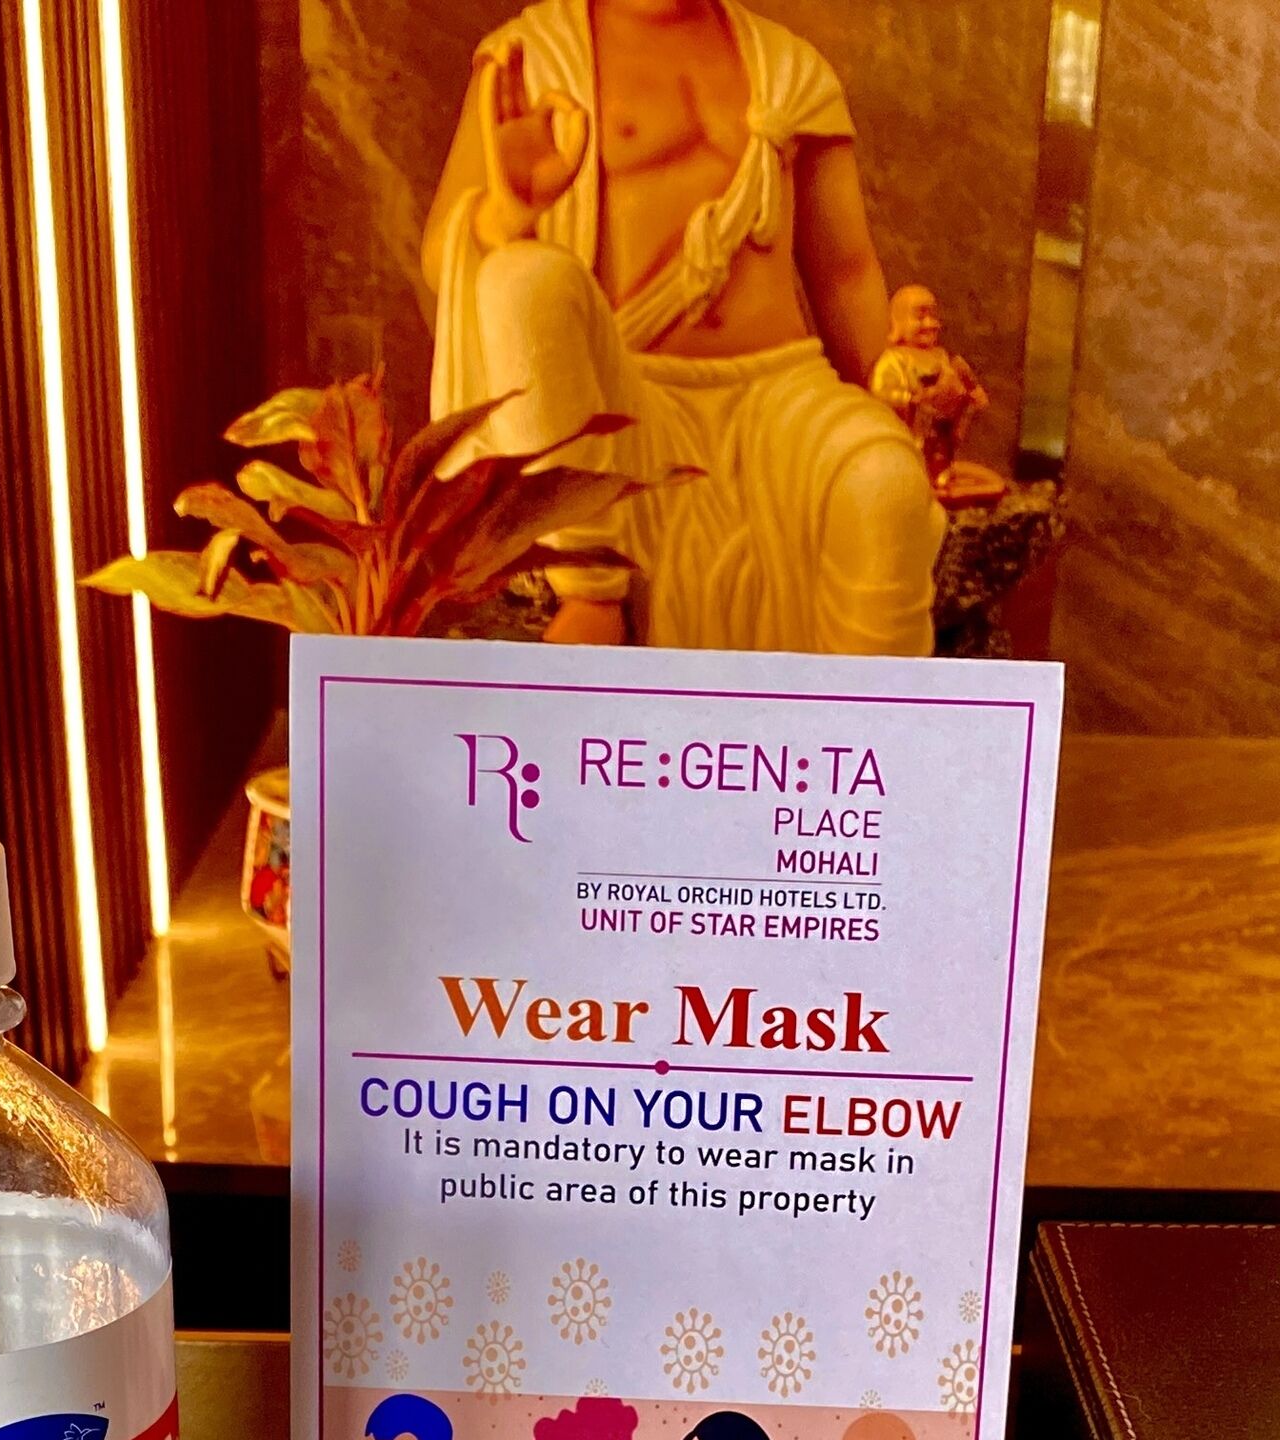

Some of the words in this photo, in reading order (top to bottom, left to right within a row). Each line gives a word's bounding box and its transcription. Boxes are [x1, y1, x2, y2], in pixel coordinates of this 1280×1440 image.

[774, 808, 882, 839] PLACE
[777, 850, 878, 876] MOHALI
[577, 882, 602, 899] BY
[608, 883, 671, 903] ROYAL
[678, 886, 754, 906] ORCHID
[760, 889, 837, 909] HOTELS
[843, 892, 886, 910] LTD.
[581, 909, 643, 933] UNIT
[650, 912, 683, 934] OF
[691, 913, 756, 937] STAR
[763, 916, 879, 940] EMPIRES
[439, 976, 648, 1043] Wear
[673, 985, 890, 1052] Mask
[361, 1078, 528, 1122] COUGH
[549, 1085, 616, 1126] ON
[634, 1088, 763, 1132] YOUR
[783, 1095, 961, 1138] ELBOW
[404, 1128, 422, 1154] It
[435, 1130, 460, 1155] is
[474, 1132, 645, 1169] mandatory
[656, 1140, 685, 1164] to
[698, 1145, 777, 1169] wear
[790, 1144, 875, 1173] mask
[888, 1148, 914, 1174] in
[441, 1173, 534, 1201] public
[546, 1180, 616, 1203] area
[629, 1180, 657, 1205] of
[670, 1181, 726, 1208] this
[739, 1188, 875, 1220] property
